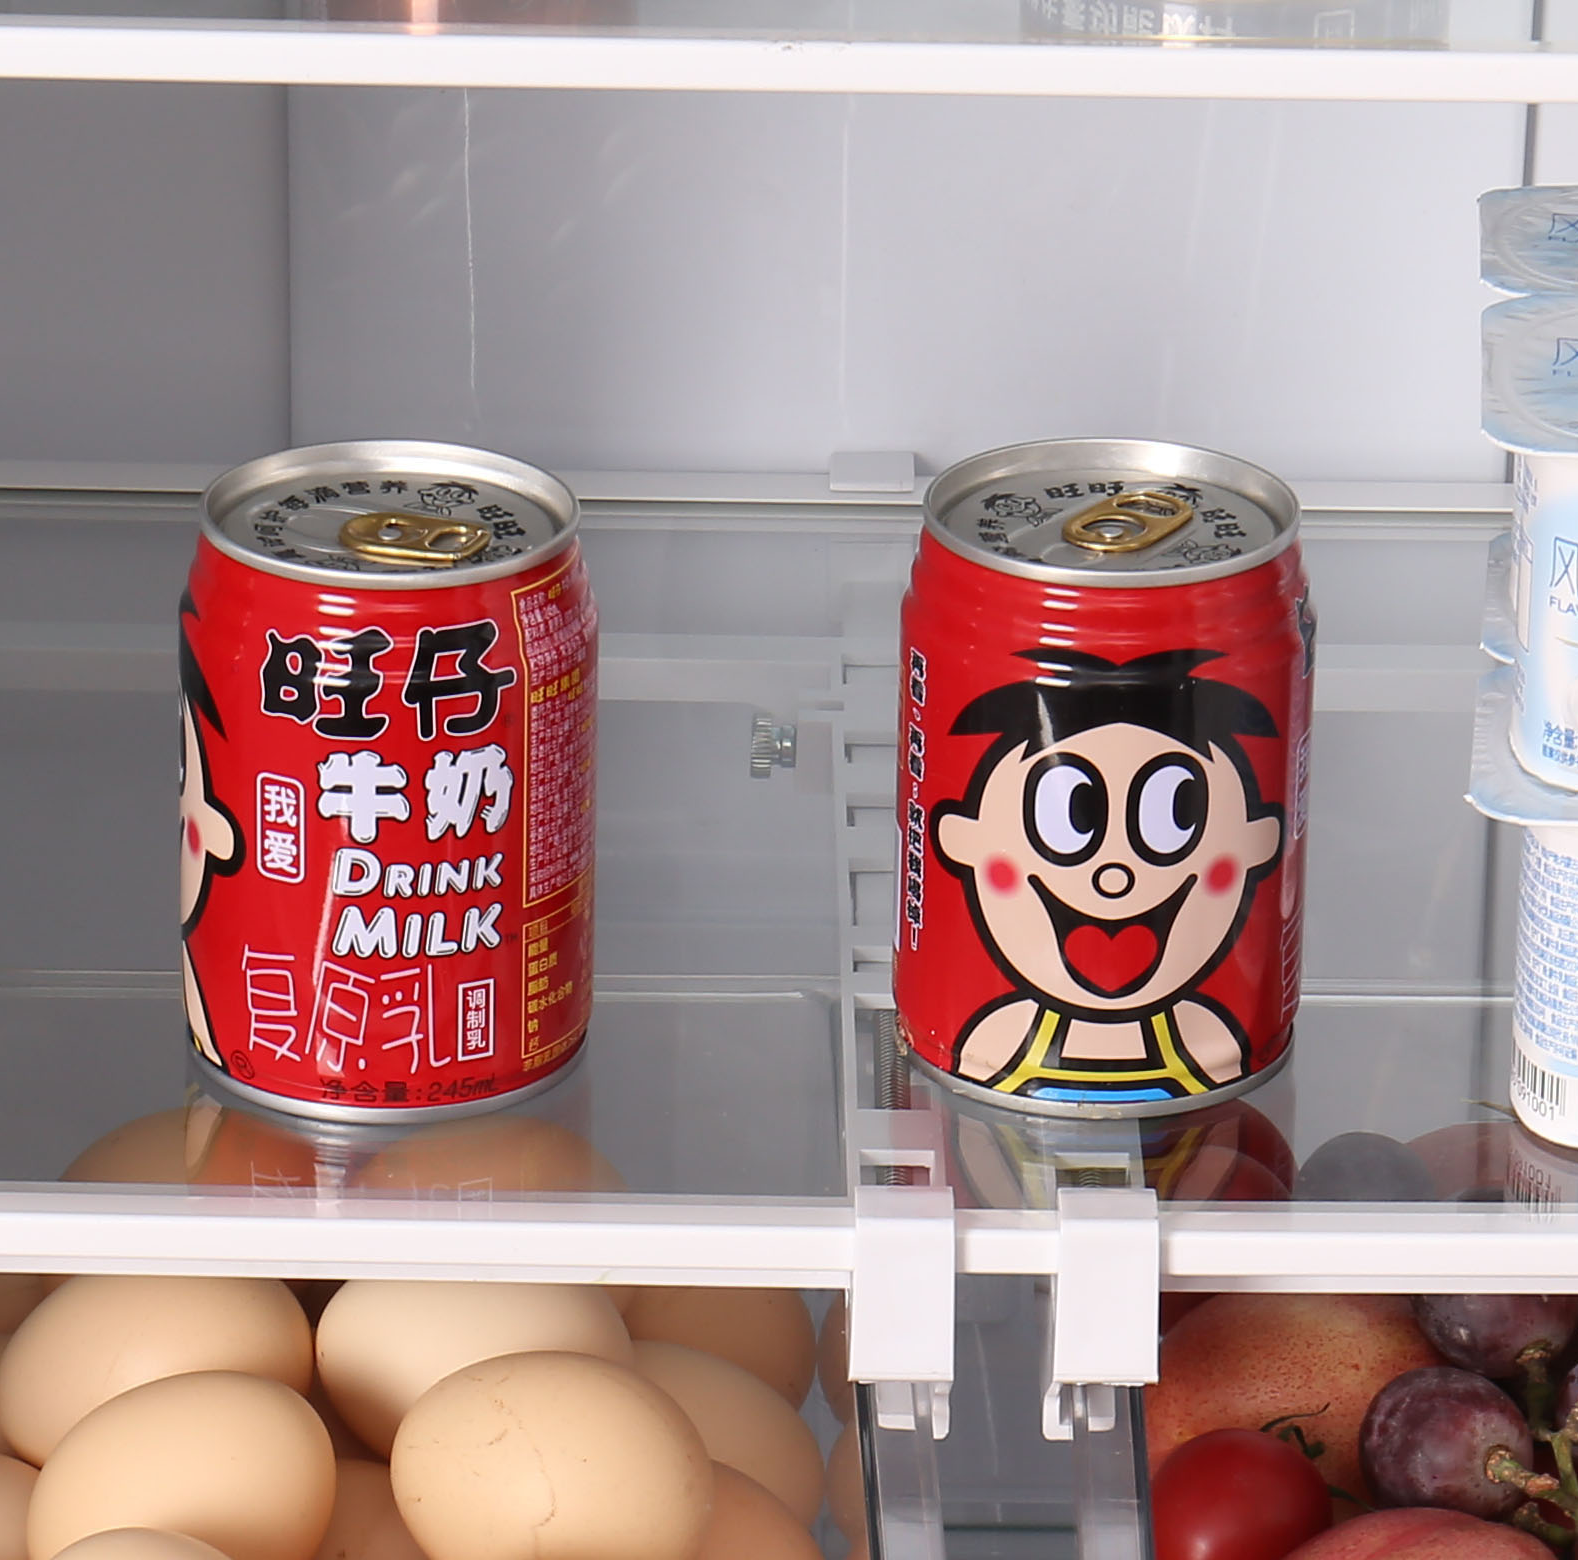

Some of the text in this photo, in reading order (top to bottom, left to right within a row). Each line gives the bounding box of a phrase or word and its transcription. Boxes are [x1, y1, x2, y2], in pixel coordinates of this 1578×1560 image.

[259, 617, 517, 741] 旺仔
[262, 782, 297, 875] 我爱
[317, 743, 516, 842] 牛奶
[331, 848, 503, 900] DRINK
[331, 904, 502, 959] MILK
[242, 945, 452, 1075] 复原乳
[466, 989, 486, 1050] 调制乳
